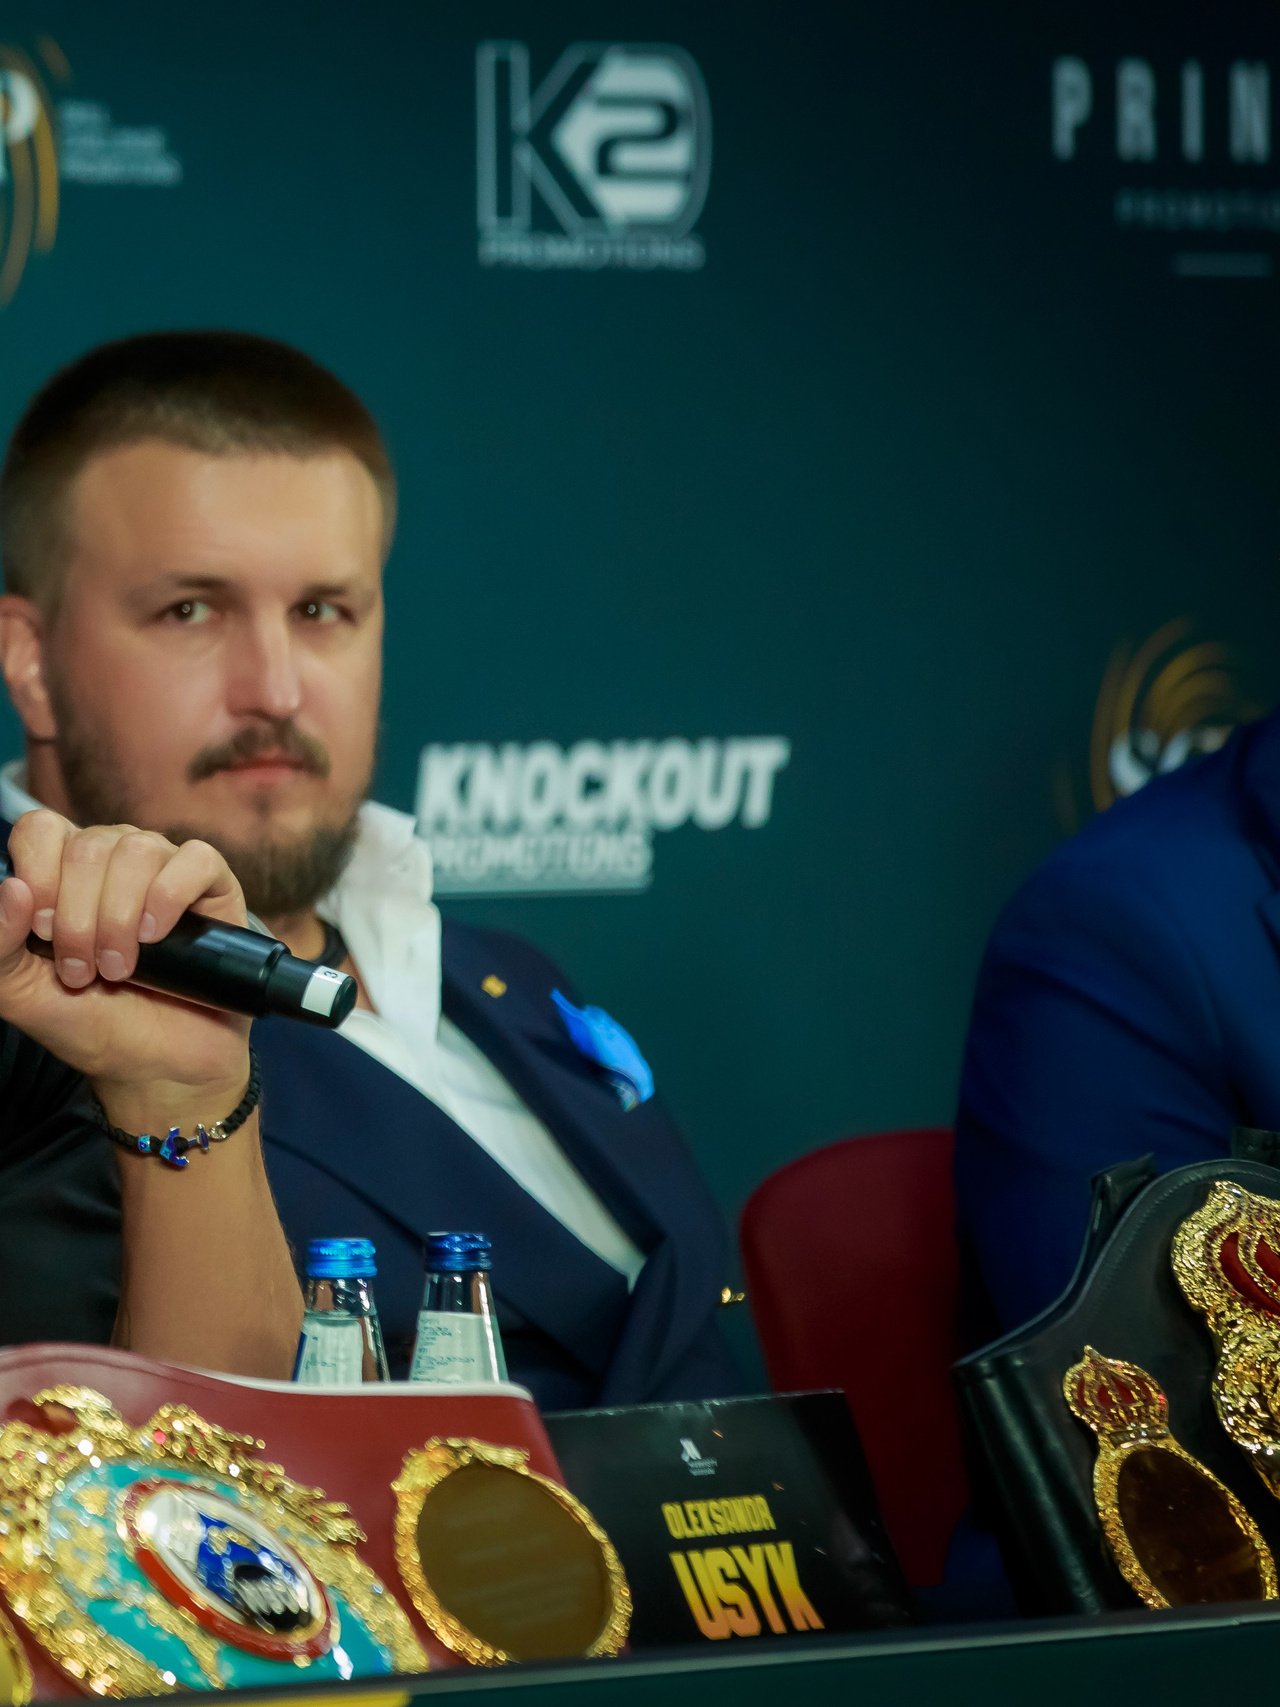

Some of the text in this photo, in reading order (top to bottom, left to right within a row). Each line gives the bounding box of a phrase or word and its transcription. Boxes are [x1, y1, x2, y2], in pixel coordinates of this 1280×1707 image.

[476, 40, 713, 238] K2
[417, 735, 791, 831] KNOCKOUT
[431, 831, 652, 880] ROMOTIONS
[669, 1540, 825, 1641] USYK
